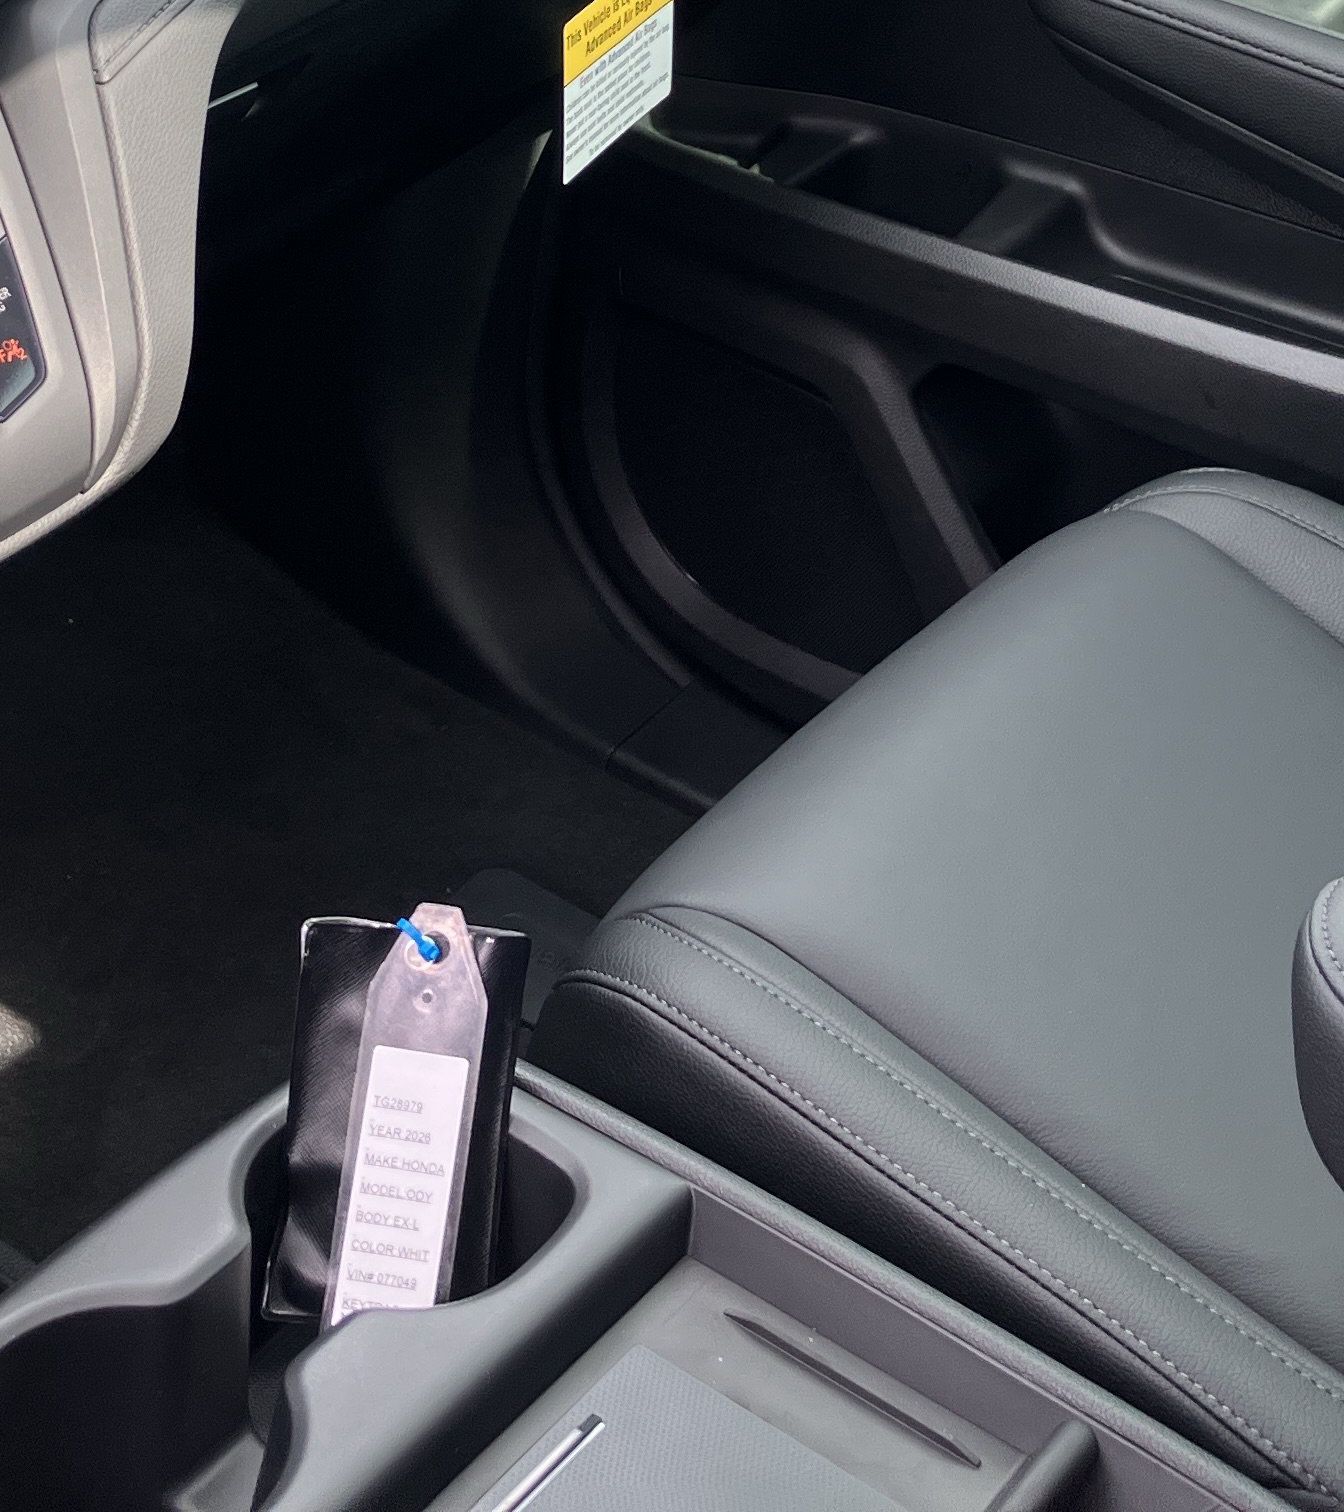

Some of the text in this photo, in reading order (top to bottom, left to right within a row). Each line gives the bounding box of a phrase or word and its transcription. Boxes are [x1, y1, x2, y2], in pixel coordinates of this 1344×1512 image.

[566, 28, 582, 50] This
[584, 6, 610, 36] Vehicle
[585, 16, 622, 58] Advanced
[623, 9, 634, 28] Air
[373, 1095, 423, 1113] TG28979
[369, 1123, 402, 1139] YEAR
[365, 1152, 445, 1176] MAKE HONDA
[360, 1182, 433, 1202] MODEL ODY
[356, 1209, 390, 1226] BODY
[351, 1239, 430, 1262] COLOR WHIT
